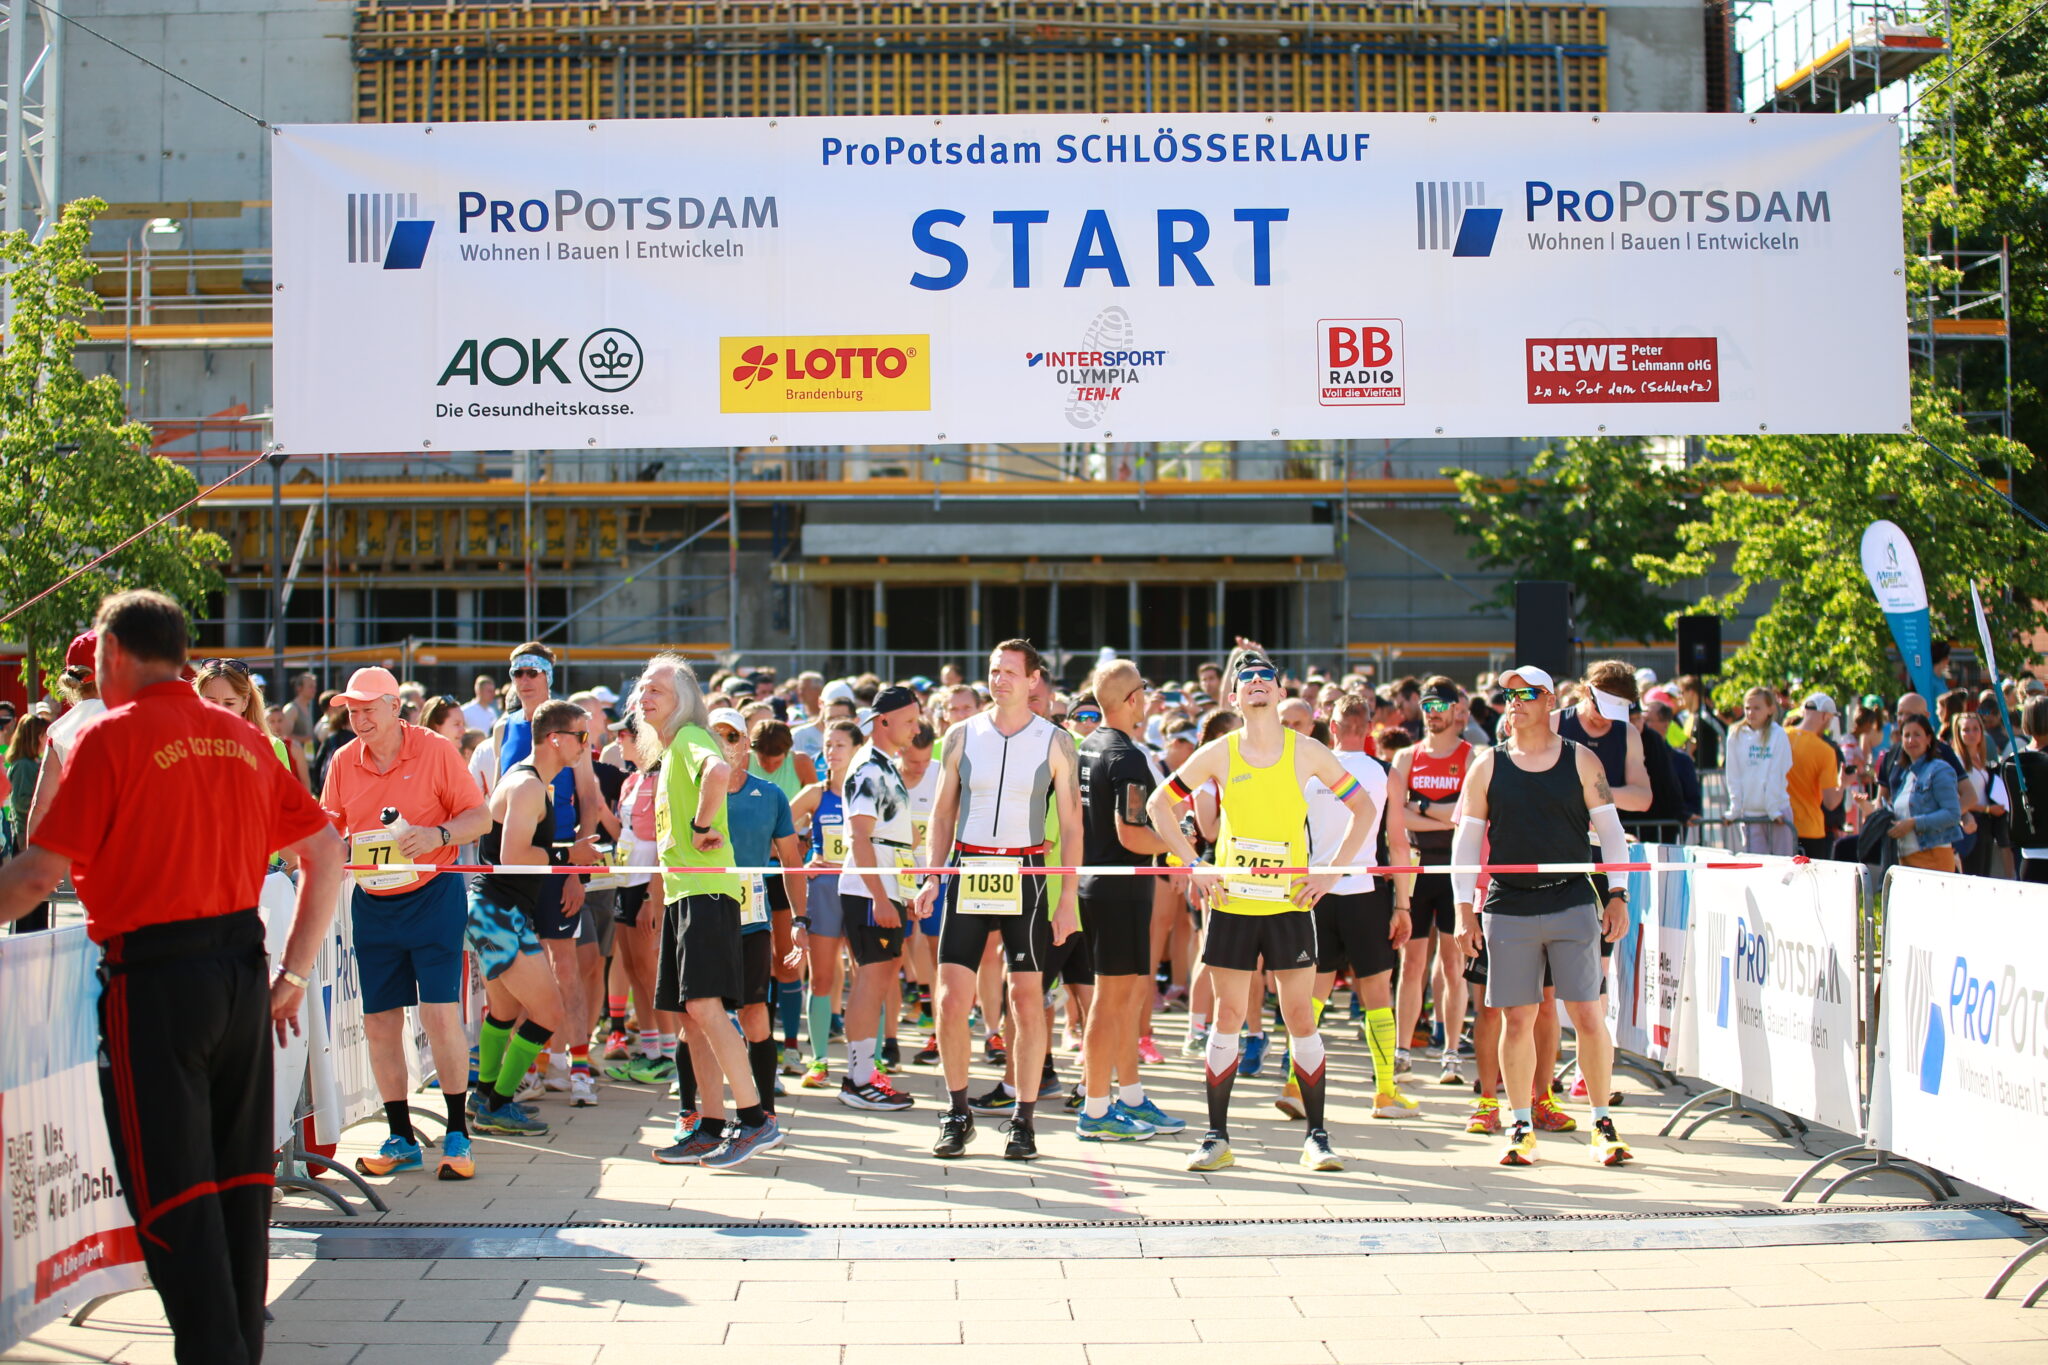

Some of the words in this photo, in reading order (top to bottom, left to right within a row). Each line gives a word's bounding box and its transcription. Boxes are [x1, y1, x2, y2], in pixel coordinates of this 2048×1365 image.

[822, 136, 1041, 166] ProPotsdam
[1056, 128, 1370, 163] SCHLÖSSERLAUF
[909, 208, 1290, 291] START
[1528, 232, 1604, 250] Wohnen
[1621, 232, 1680, 250] Bauen
[1697, 232, 1799, 250] Entwickeln
[460, 243, 540, 262] Wohnen
[557, 242, 619, 260] Bauen
[637, 239, 744, 259] Entwickeln
[1329, 327, 1393, 368] BB
[1631, 344, 1663, 356] Peter
[436, 337, 572, 386] AOK
[1046, 351, 1166, 367] INTERSPORT
[1532, 344, 1628, 372] REWE
[1632, 360, 1684, 371] Lehmann
[1687, 359, 1712, 371] oHG
[1057, 369, 1139, 384] OLYMPIA
[1330, 370, 1393, 384] RADIO
[786, 388, 863, 401] Brandenburg
[1077, 387, 1122, 401] TEN-K
[1324, 388, 1342, 397] Voll
[1345, 388, 1360, 397] die
[1363, 388, 1399, 397] Vielfalt
[1558, 385, 1571, 396] in
[436, 403, 463, 418] Die
[468, 402, 634, 418] Gesundheitskasse.
[153, 740, 188, 769] OSC
[1413, 776, 1460, 790] GERMANY
[368, 846, 391, 865] 77
[1235, 855, 1285, 879] 3457
[968, 874, 1014, 893] 1030
[1950, 956, 2048, 1061] PROPOT
